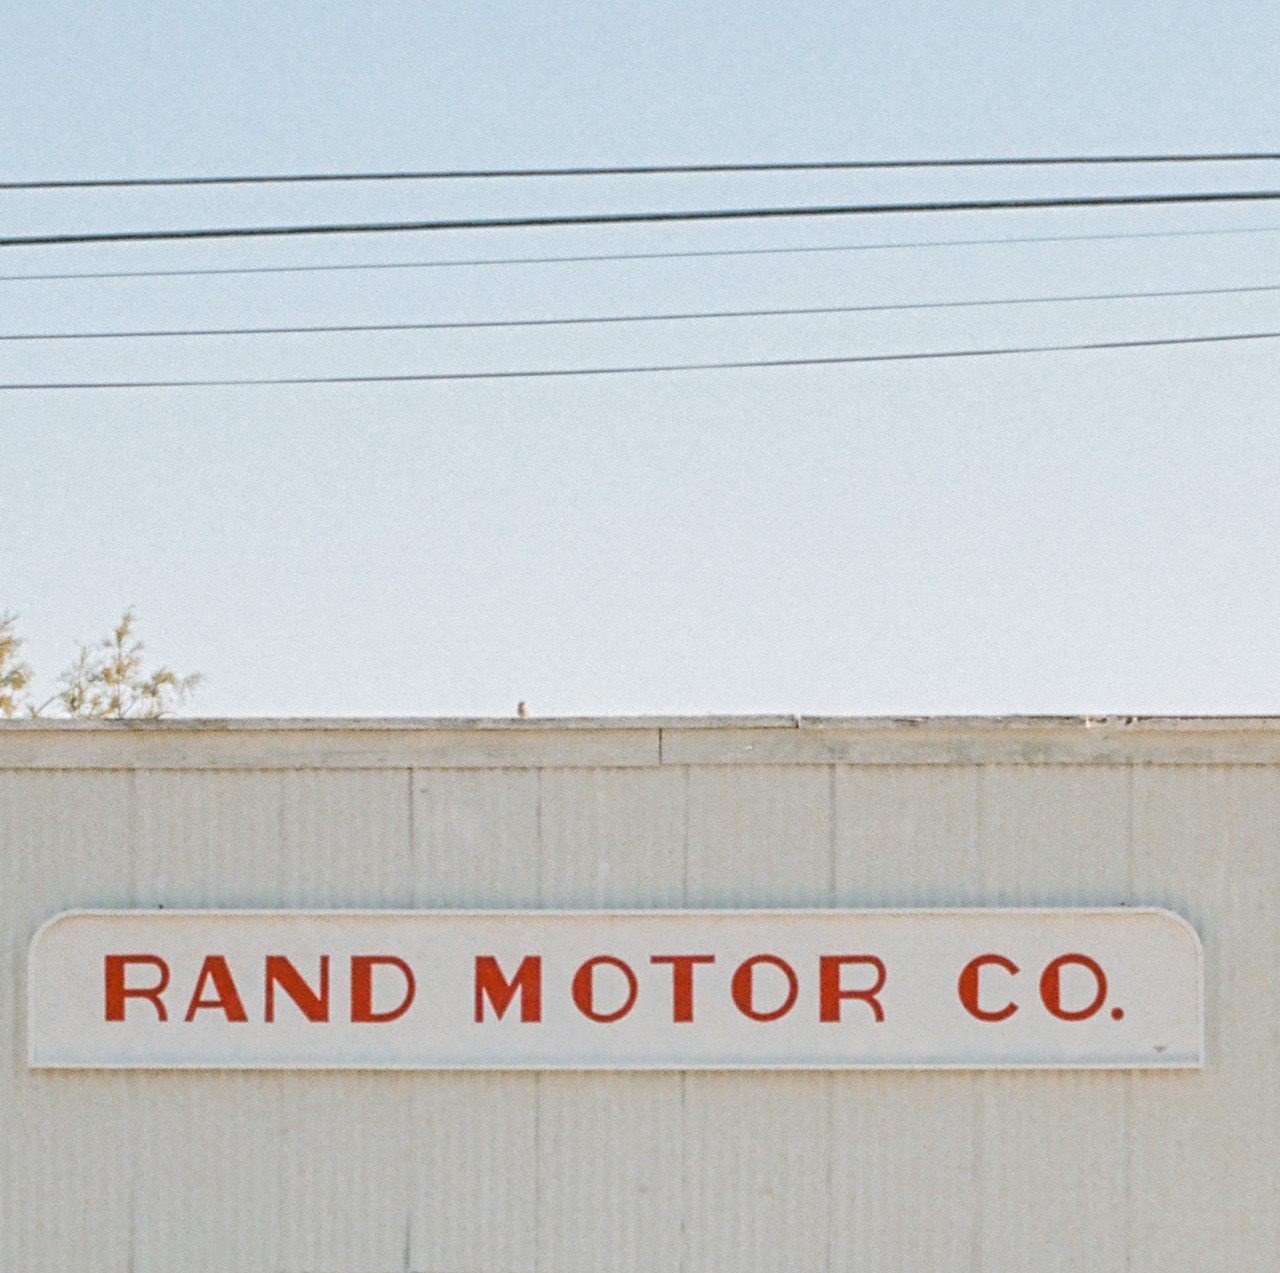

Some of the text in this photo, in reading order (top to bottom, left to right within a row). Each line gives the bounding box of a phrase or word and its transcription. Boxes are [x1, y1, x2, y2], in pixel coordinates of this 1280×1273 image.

[104, 953, 1125, 1023] RAND MOTOR CO.
